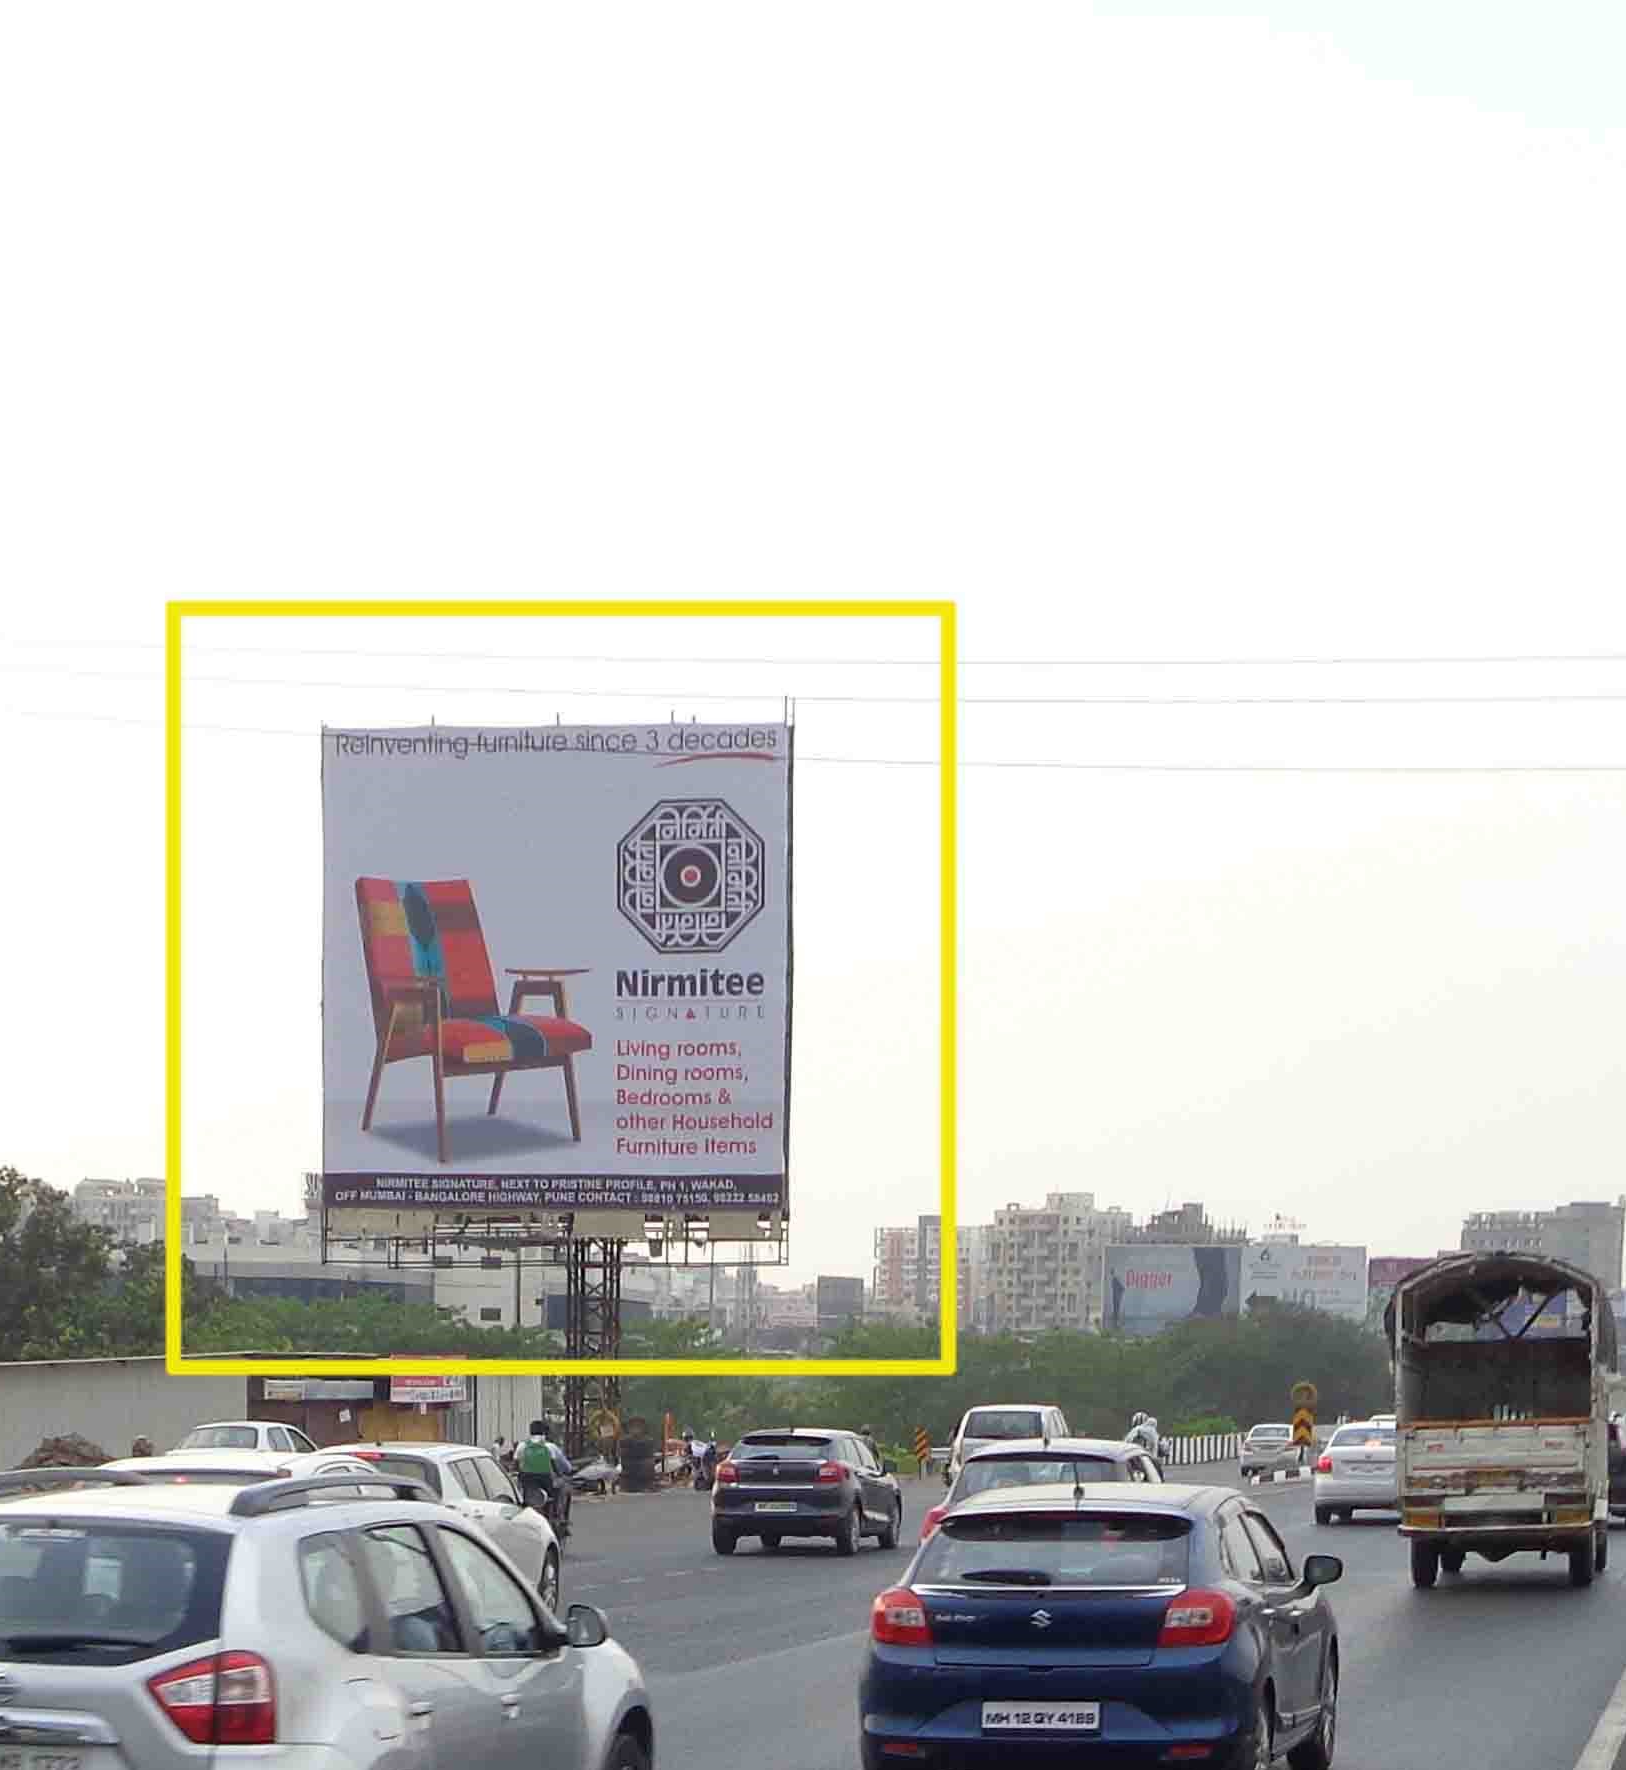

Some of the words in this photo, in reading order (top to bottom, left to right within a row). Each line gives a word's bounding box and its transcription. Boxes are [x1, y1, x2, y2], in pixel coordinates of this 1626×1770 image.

[335, 733, 469, 760] Reinventing
[477, 729, 567, 752] furniture
[576, 730, 637, 752] since
[646, 729, 660, 751] 3
[668, 727, 777, 750] decades
[616, 969, 765, 997] Nirmitee
[615, 1005, 765, 1021] SIGNATURE
[616, 1039, 671, 1060] Living
[677, 1040, 742, 1059] rooms,
[616, 1064, 678, 1085] Dining
[684, 1064, 749, 1083] rooms,
[616, 1088, 711, 1105] Bedrooms
[718, 1088, 732, 1105] &
[616, 1113, 666, 1131] other
[672, 1112, 774, 1131] Household
[616, 1137, 698, 1156] Furniture
[705, 1137, 758, 1155] Items
[533, 1179, 549, 1189] TO
[335, 1191, 357, 1202] OFF
[416, 1191, 485, 1202] BANGALORE
[545, 1192, 574, 1203] PUNE
[578, 1192, 631, 1203] CONTACT
